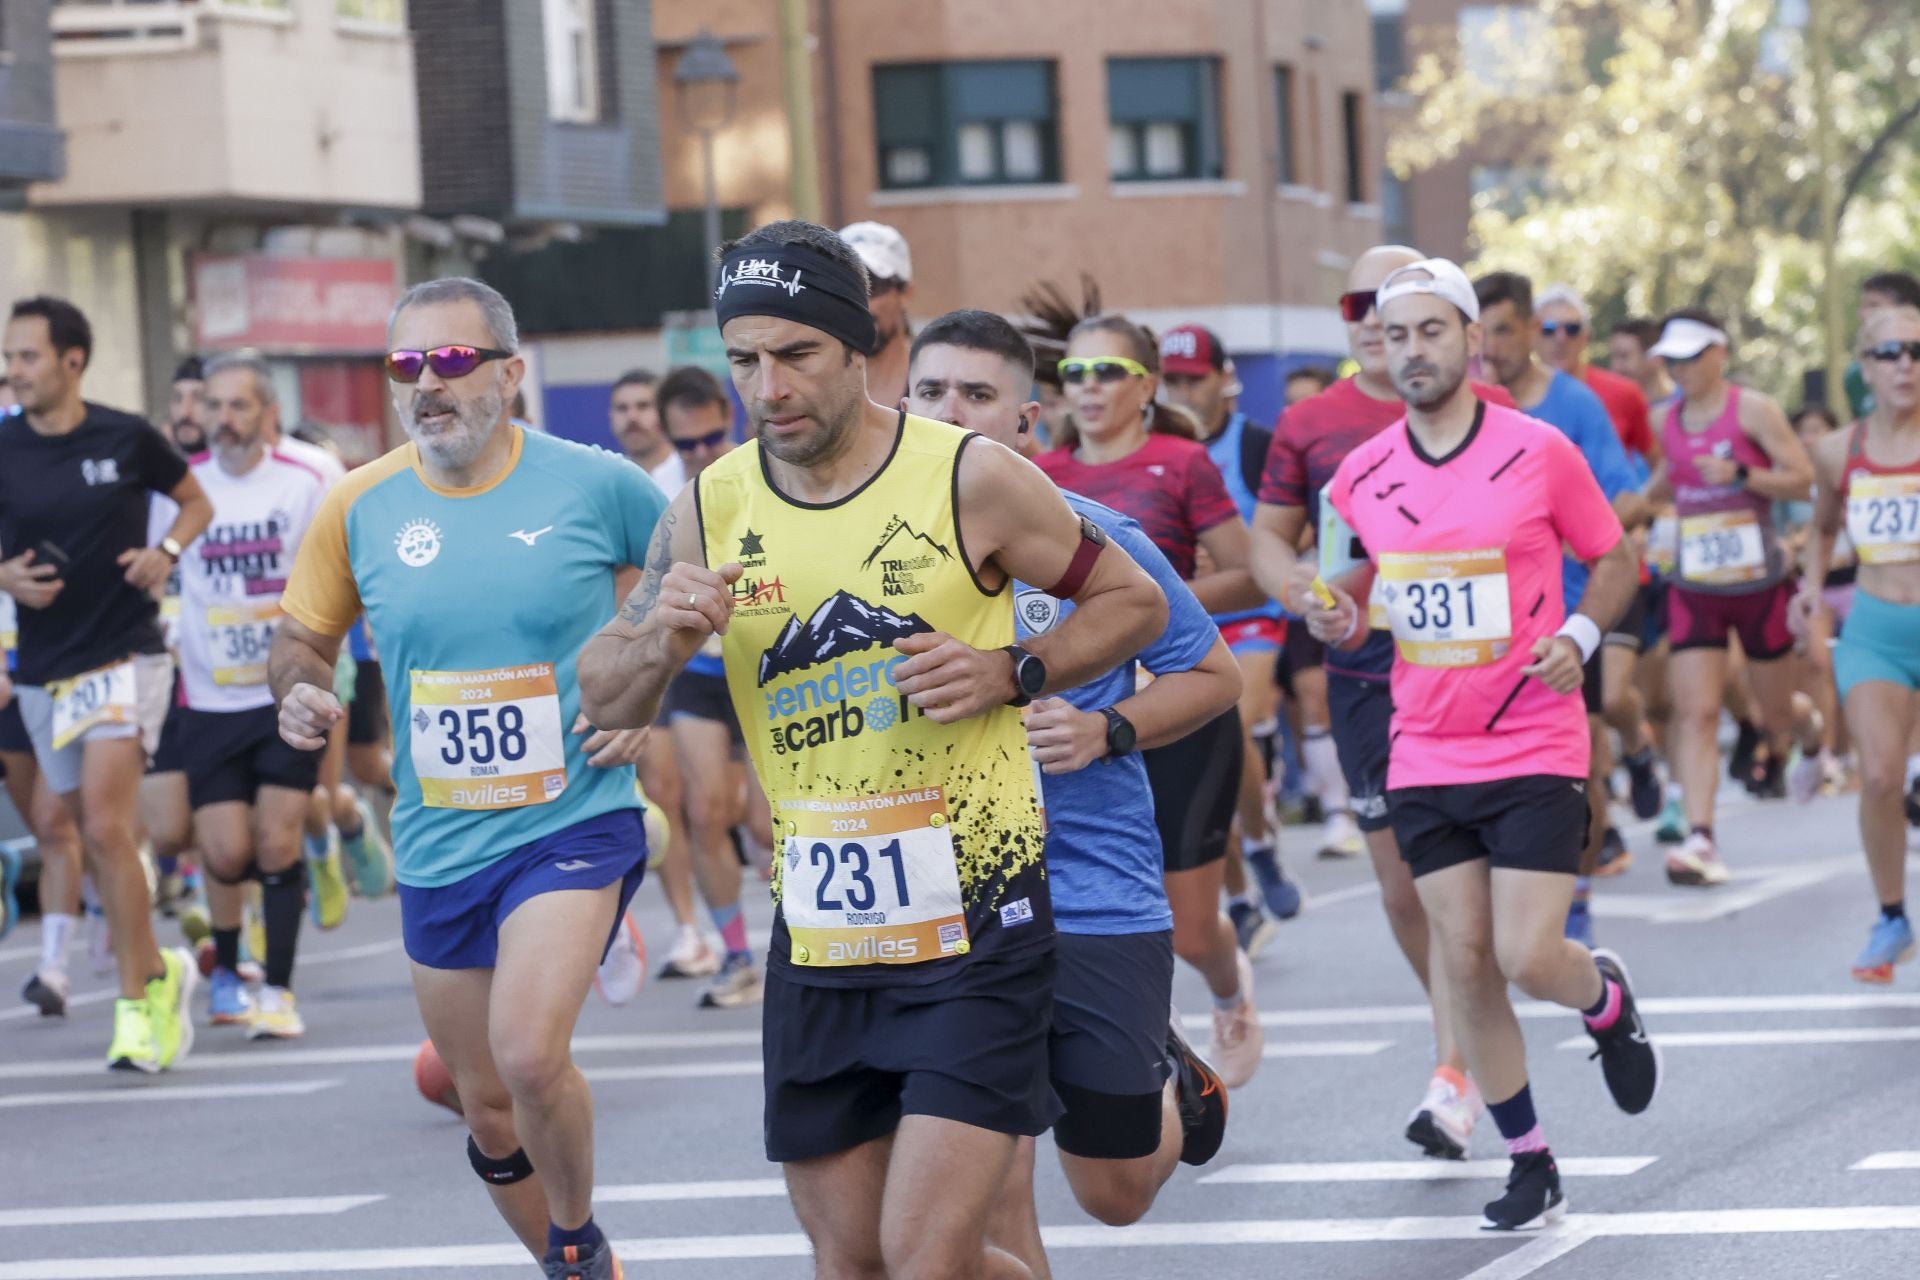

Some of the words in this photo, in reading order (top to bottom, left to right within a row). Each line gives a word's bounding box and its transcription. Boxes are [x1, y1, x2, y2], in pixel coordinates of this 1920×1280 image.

[1868, 500, 1919, 535] 237
[1407, 581, 1475, 629] 331
[463, 668, 515, 683] MARATÓN
[517, 664, 550, 679] AVILÉS
[460, 688, 492, 700] 2024
[439, 705, 527, 765] 358
[770, 727, 786, 755] del
[470, 766, 499, 776] ROMAN
[833, 796, 894, 813] MARATÓN
[896, 789, 941, 804] AVILÉS
[831, 818, 867, 832] 2024
[810, 838, 911, 911] 231
[846, 911, 886, 926] RODRIGO
[828, 932, 919, 961] avilés
